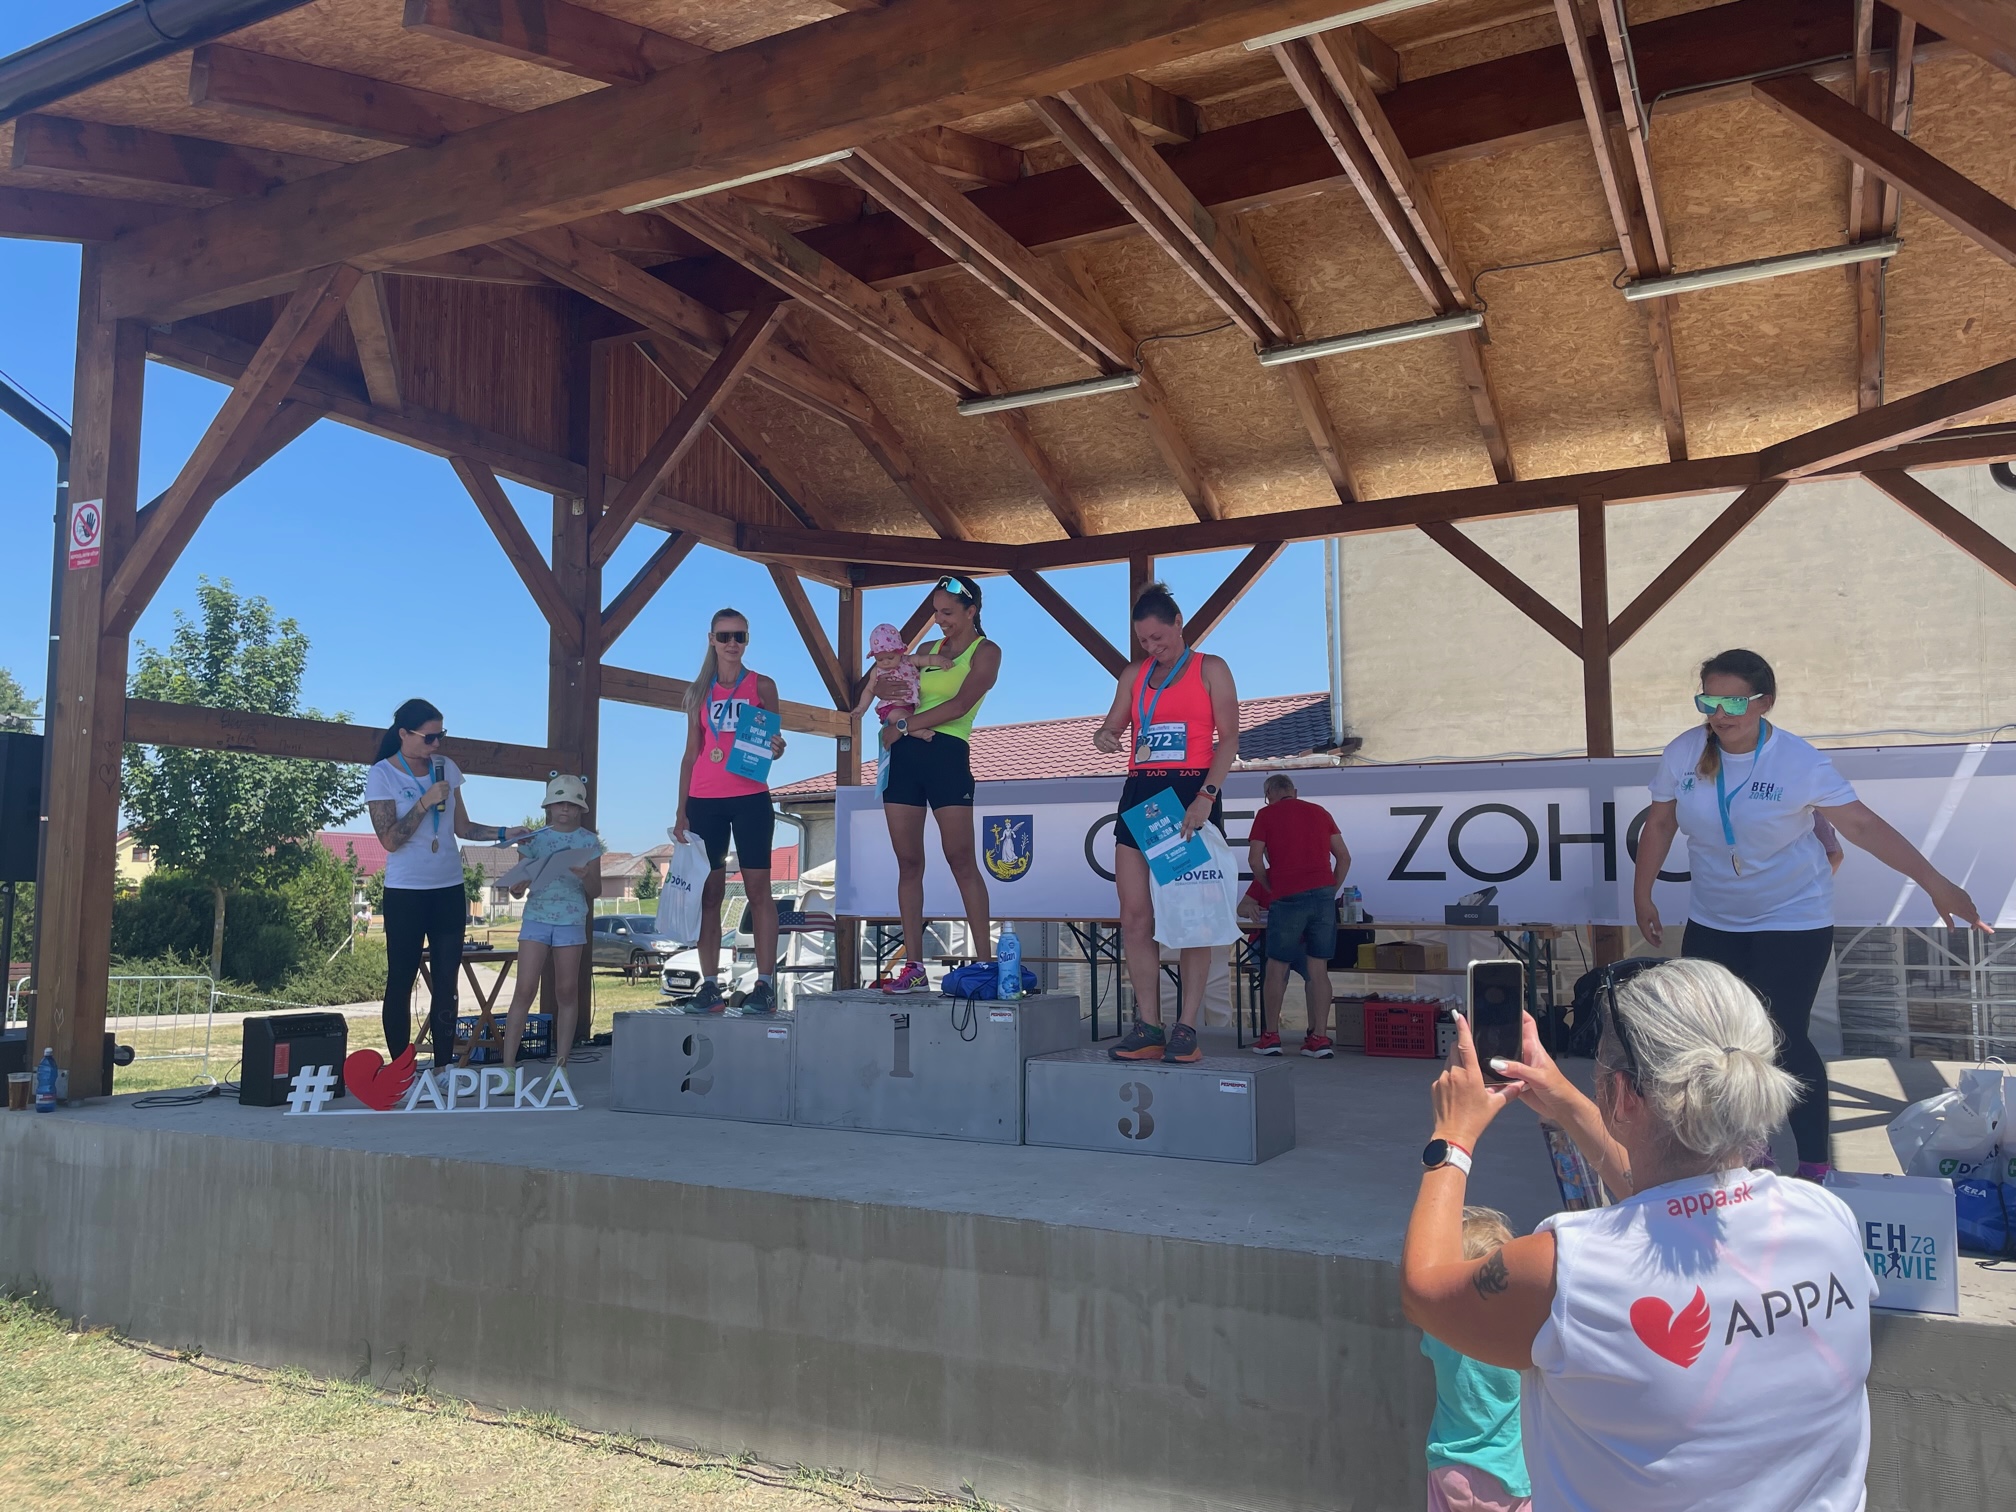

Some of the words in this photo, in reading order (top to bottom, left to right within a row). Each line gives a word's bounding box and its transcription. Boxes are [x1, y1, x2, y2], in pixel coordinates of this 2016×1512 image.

[1146, 733, 1173, 747] 272
[1751, 781, 1775, 793] BEH
[1148, 816, 1171, 833] DIPLOM
[999, 951, 1016, 963] Silan
[889, 1013, 914, 1078] 1
[680, 1033, 714, 1096] 2
[1117, 1081, 1155, 1140] 3
[1666, 1181, 1754, 1219] appa.sk
[1858, 1221, 1907, 1253] EH
[1724, 1271, 1855, 1346] APPA
